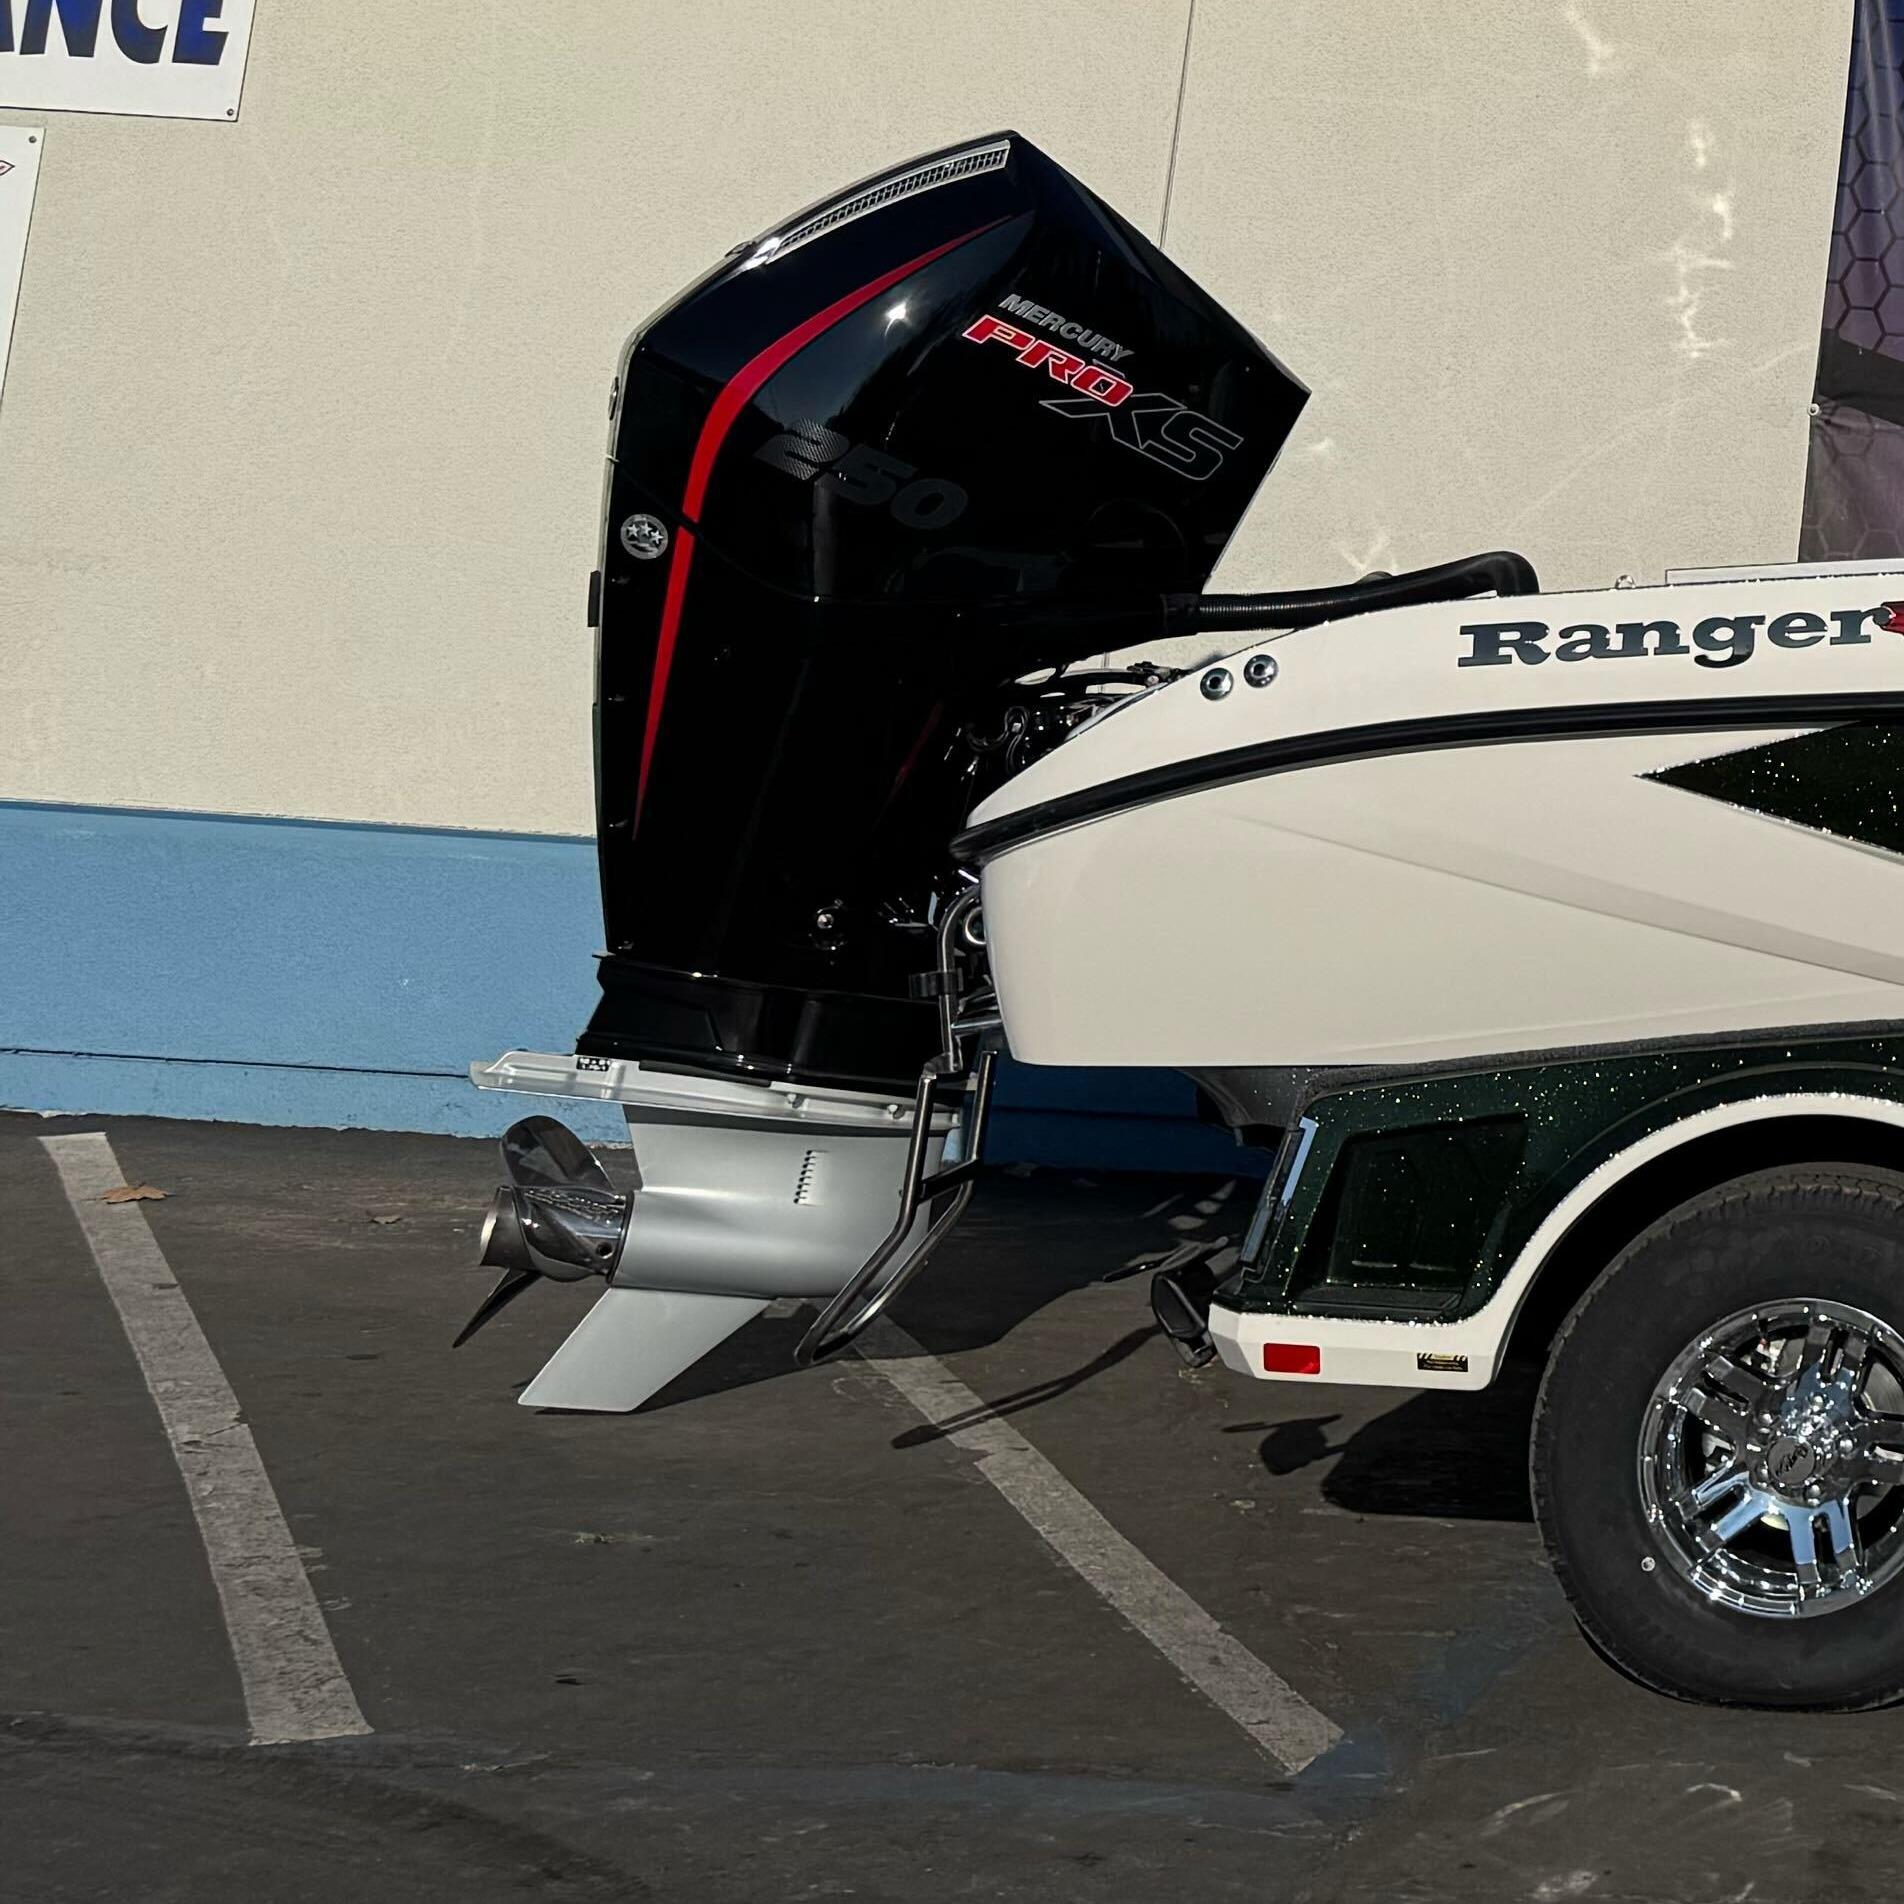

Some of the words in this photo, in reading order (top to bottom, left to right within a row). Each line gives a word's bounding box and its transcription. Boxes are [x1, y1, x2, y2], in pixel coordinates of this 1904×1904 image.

[962, 314, 1135, 407] PRO
[998, 293, 1135, 362] MERCURY
[753, 416, 969, 531] 250
[1039, 392, 1245, 481] XS
[1457, 602, 1894, 669] Ranger
